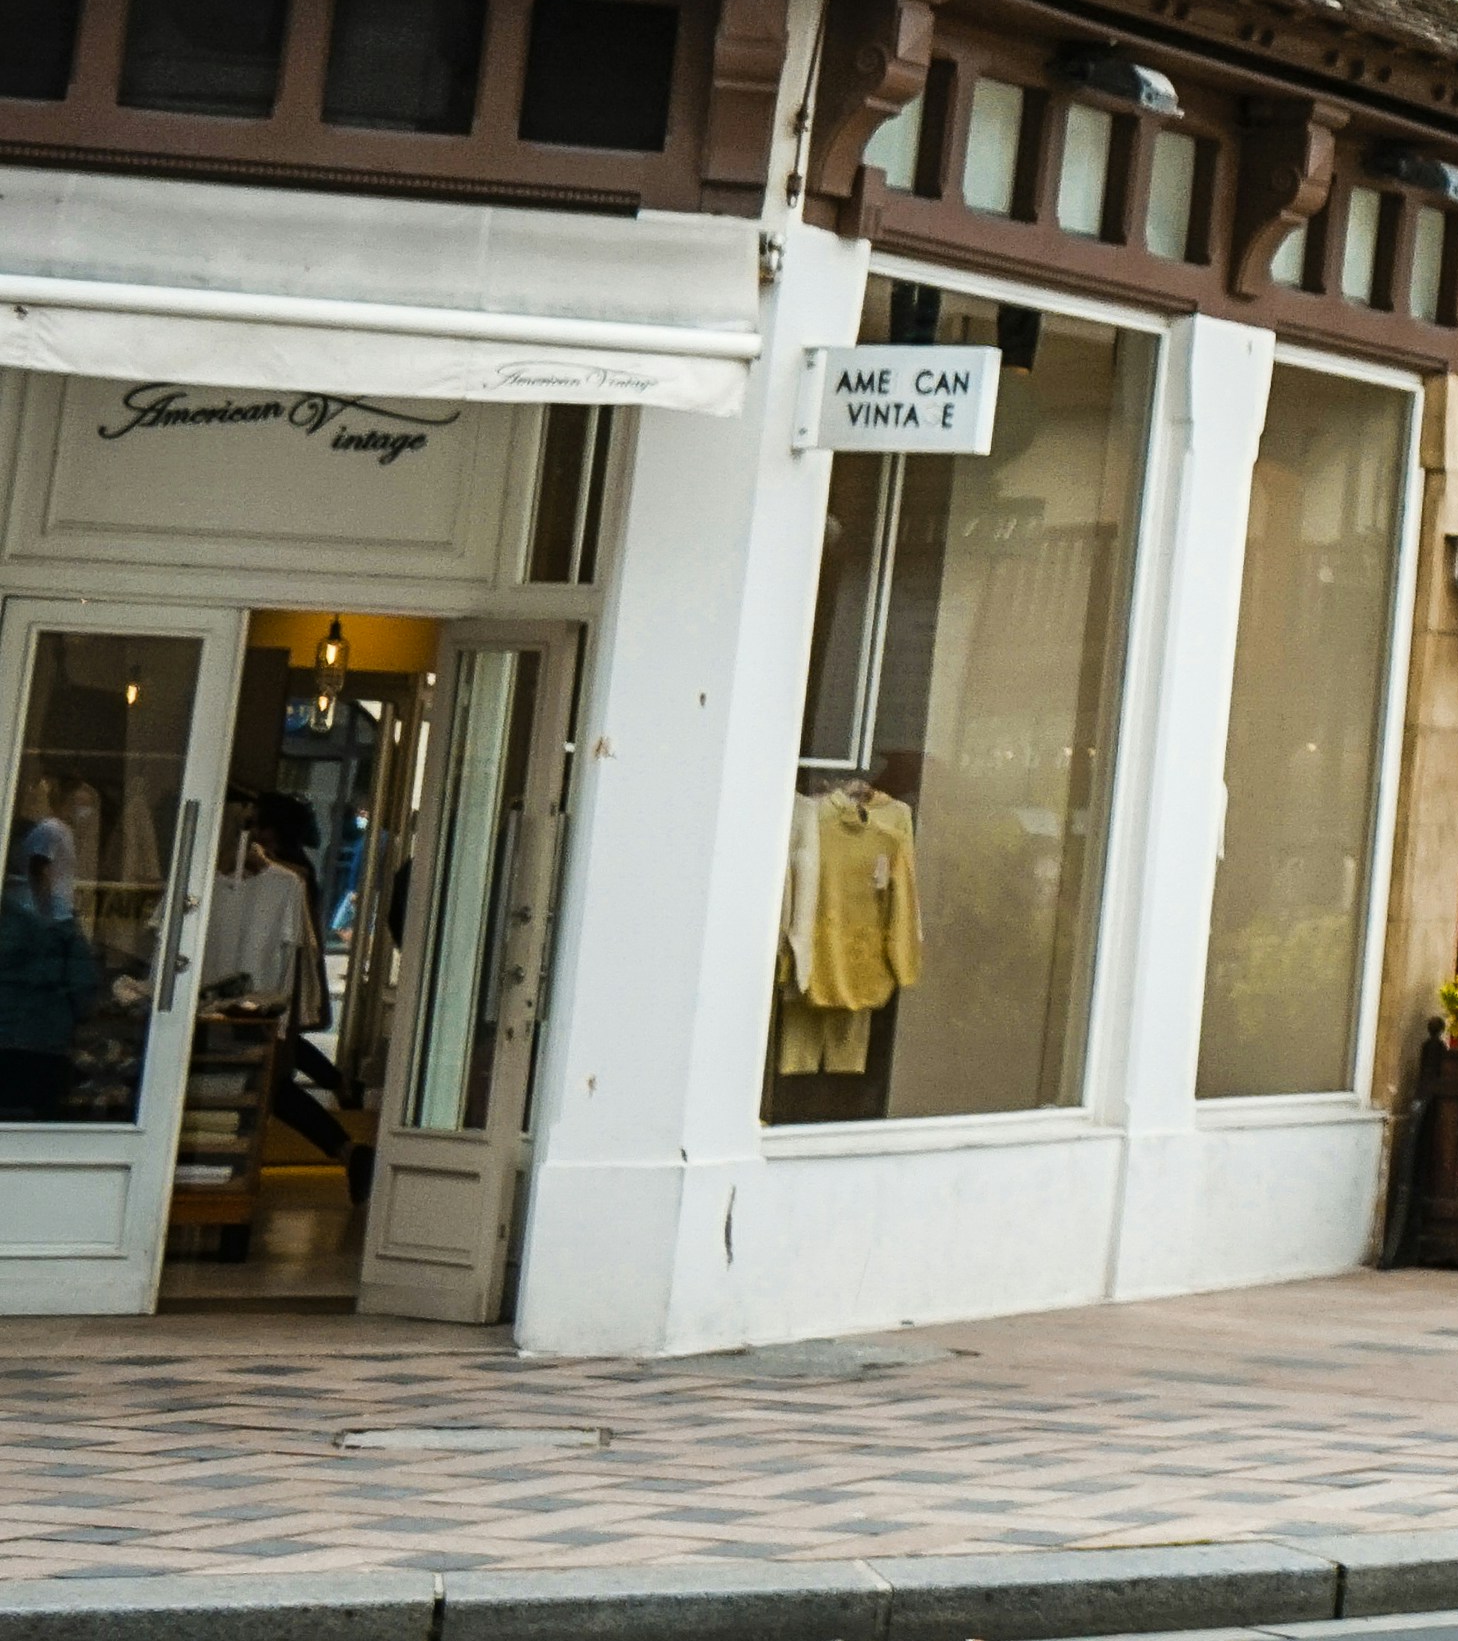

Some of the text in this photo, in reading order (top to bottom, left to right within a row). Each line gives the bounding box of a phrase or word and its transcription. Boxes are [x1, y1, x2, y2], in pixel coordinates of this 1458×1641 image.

[97, 381, 461, 465] American Vintage
[847, 401, 955, 429] VINTAE
